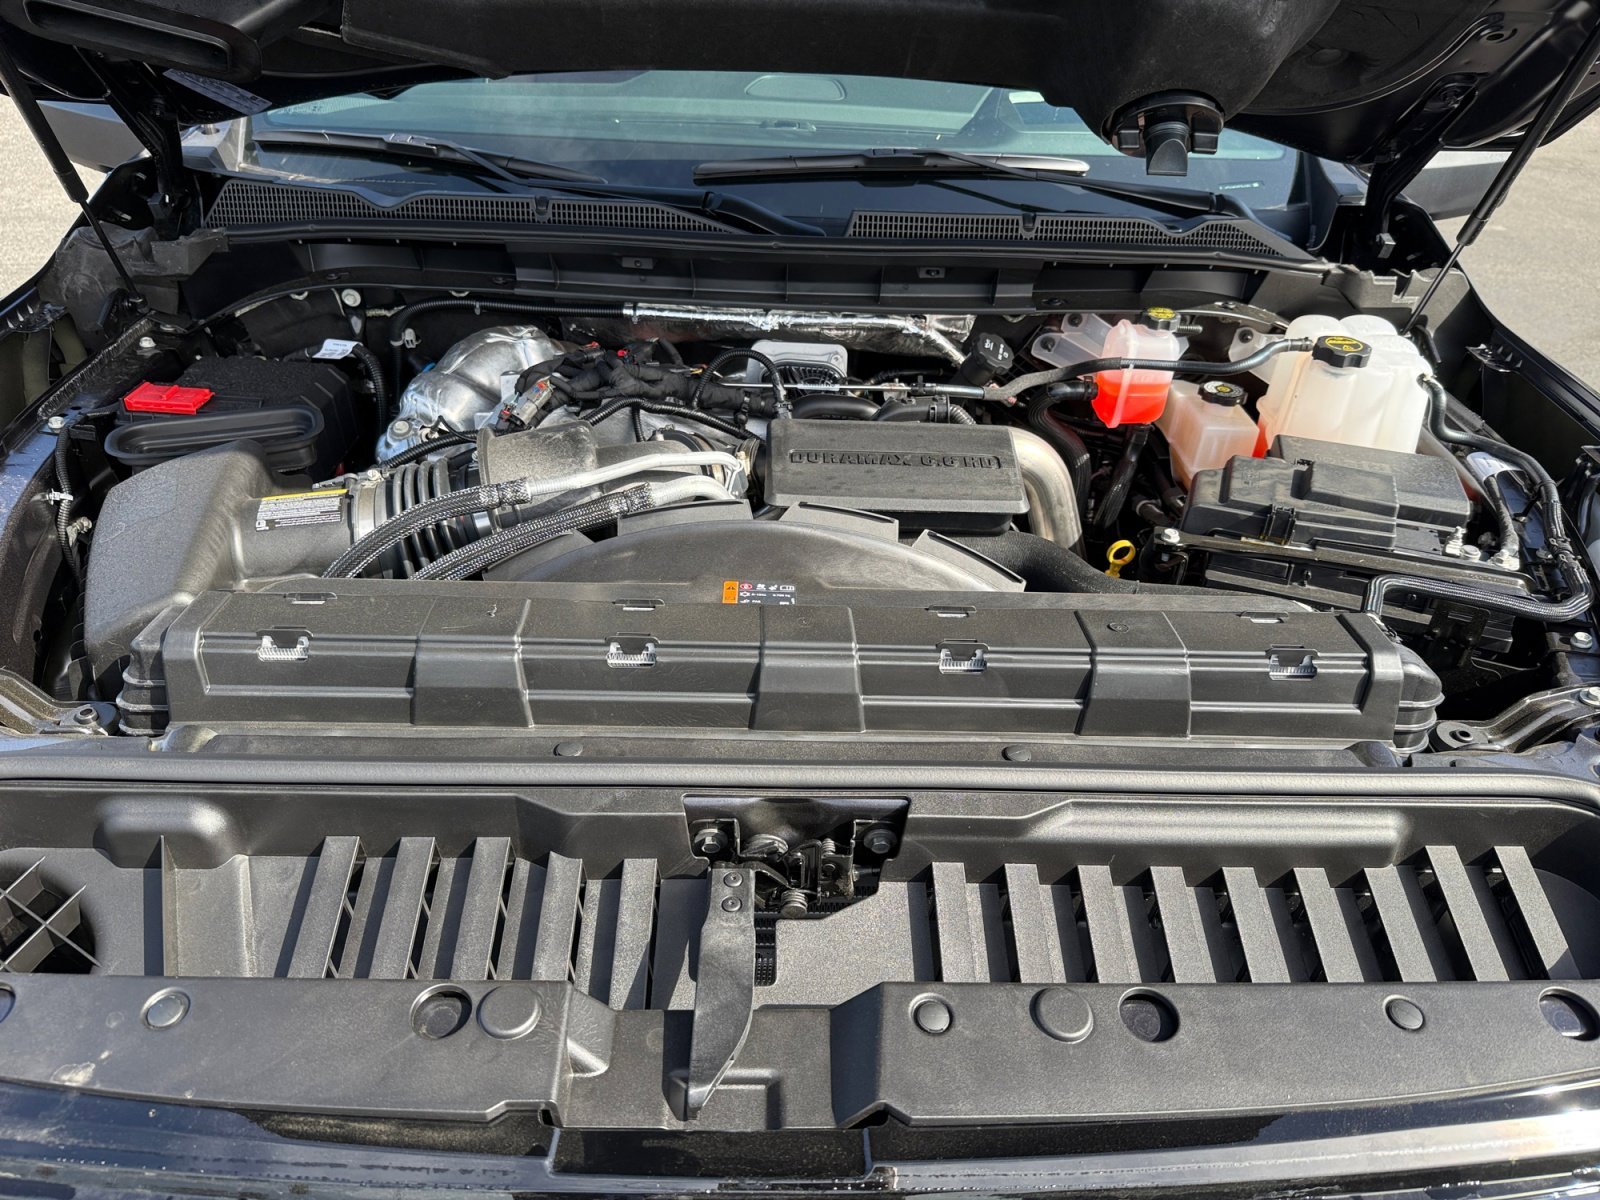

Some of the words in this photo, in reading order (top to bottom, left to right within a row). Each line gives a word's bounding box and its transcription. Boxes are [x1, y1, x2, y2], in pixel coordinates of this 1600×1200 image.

[790, 452, 912, 466] DURAMAX
[920, 455, 957, 468] 6.6
[963, 456, 997, 469] HD
